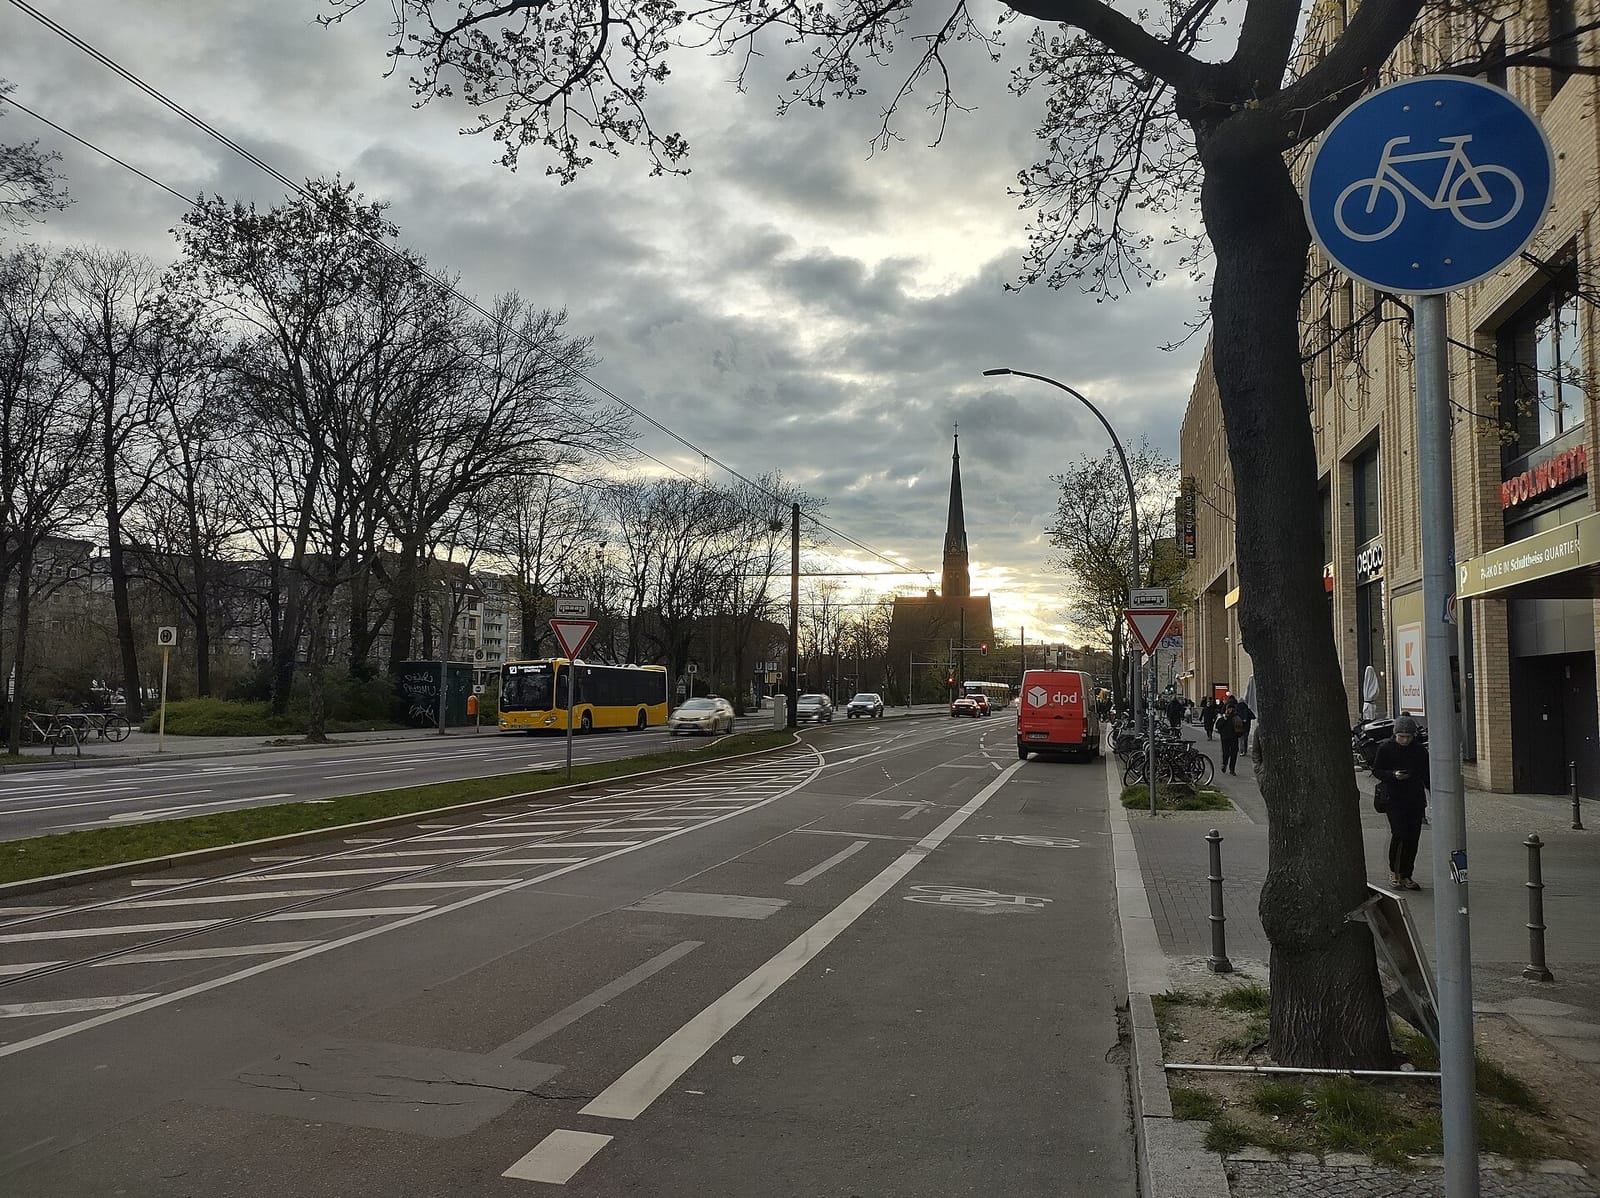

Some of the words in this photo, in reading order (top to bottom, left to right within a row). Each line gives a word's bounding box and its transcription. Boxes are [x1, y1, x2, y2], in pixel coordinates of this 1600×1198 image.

[1499, 443, 1587, 509] WOOLWORTH
[1510, 551, 1543, 571] Schultheiss
[1544, 539, 1580, 561] QUARTIER
[1052, 691, 1077, 706] dpd
